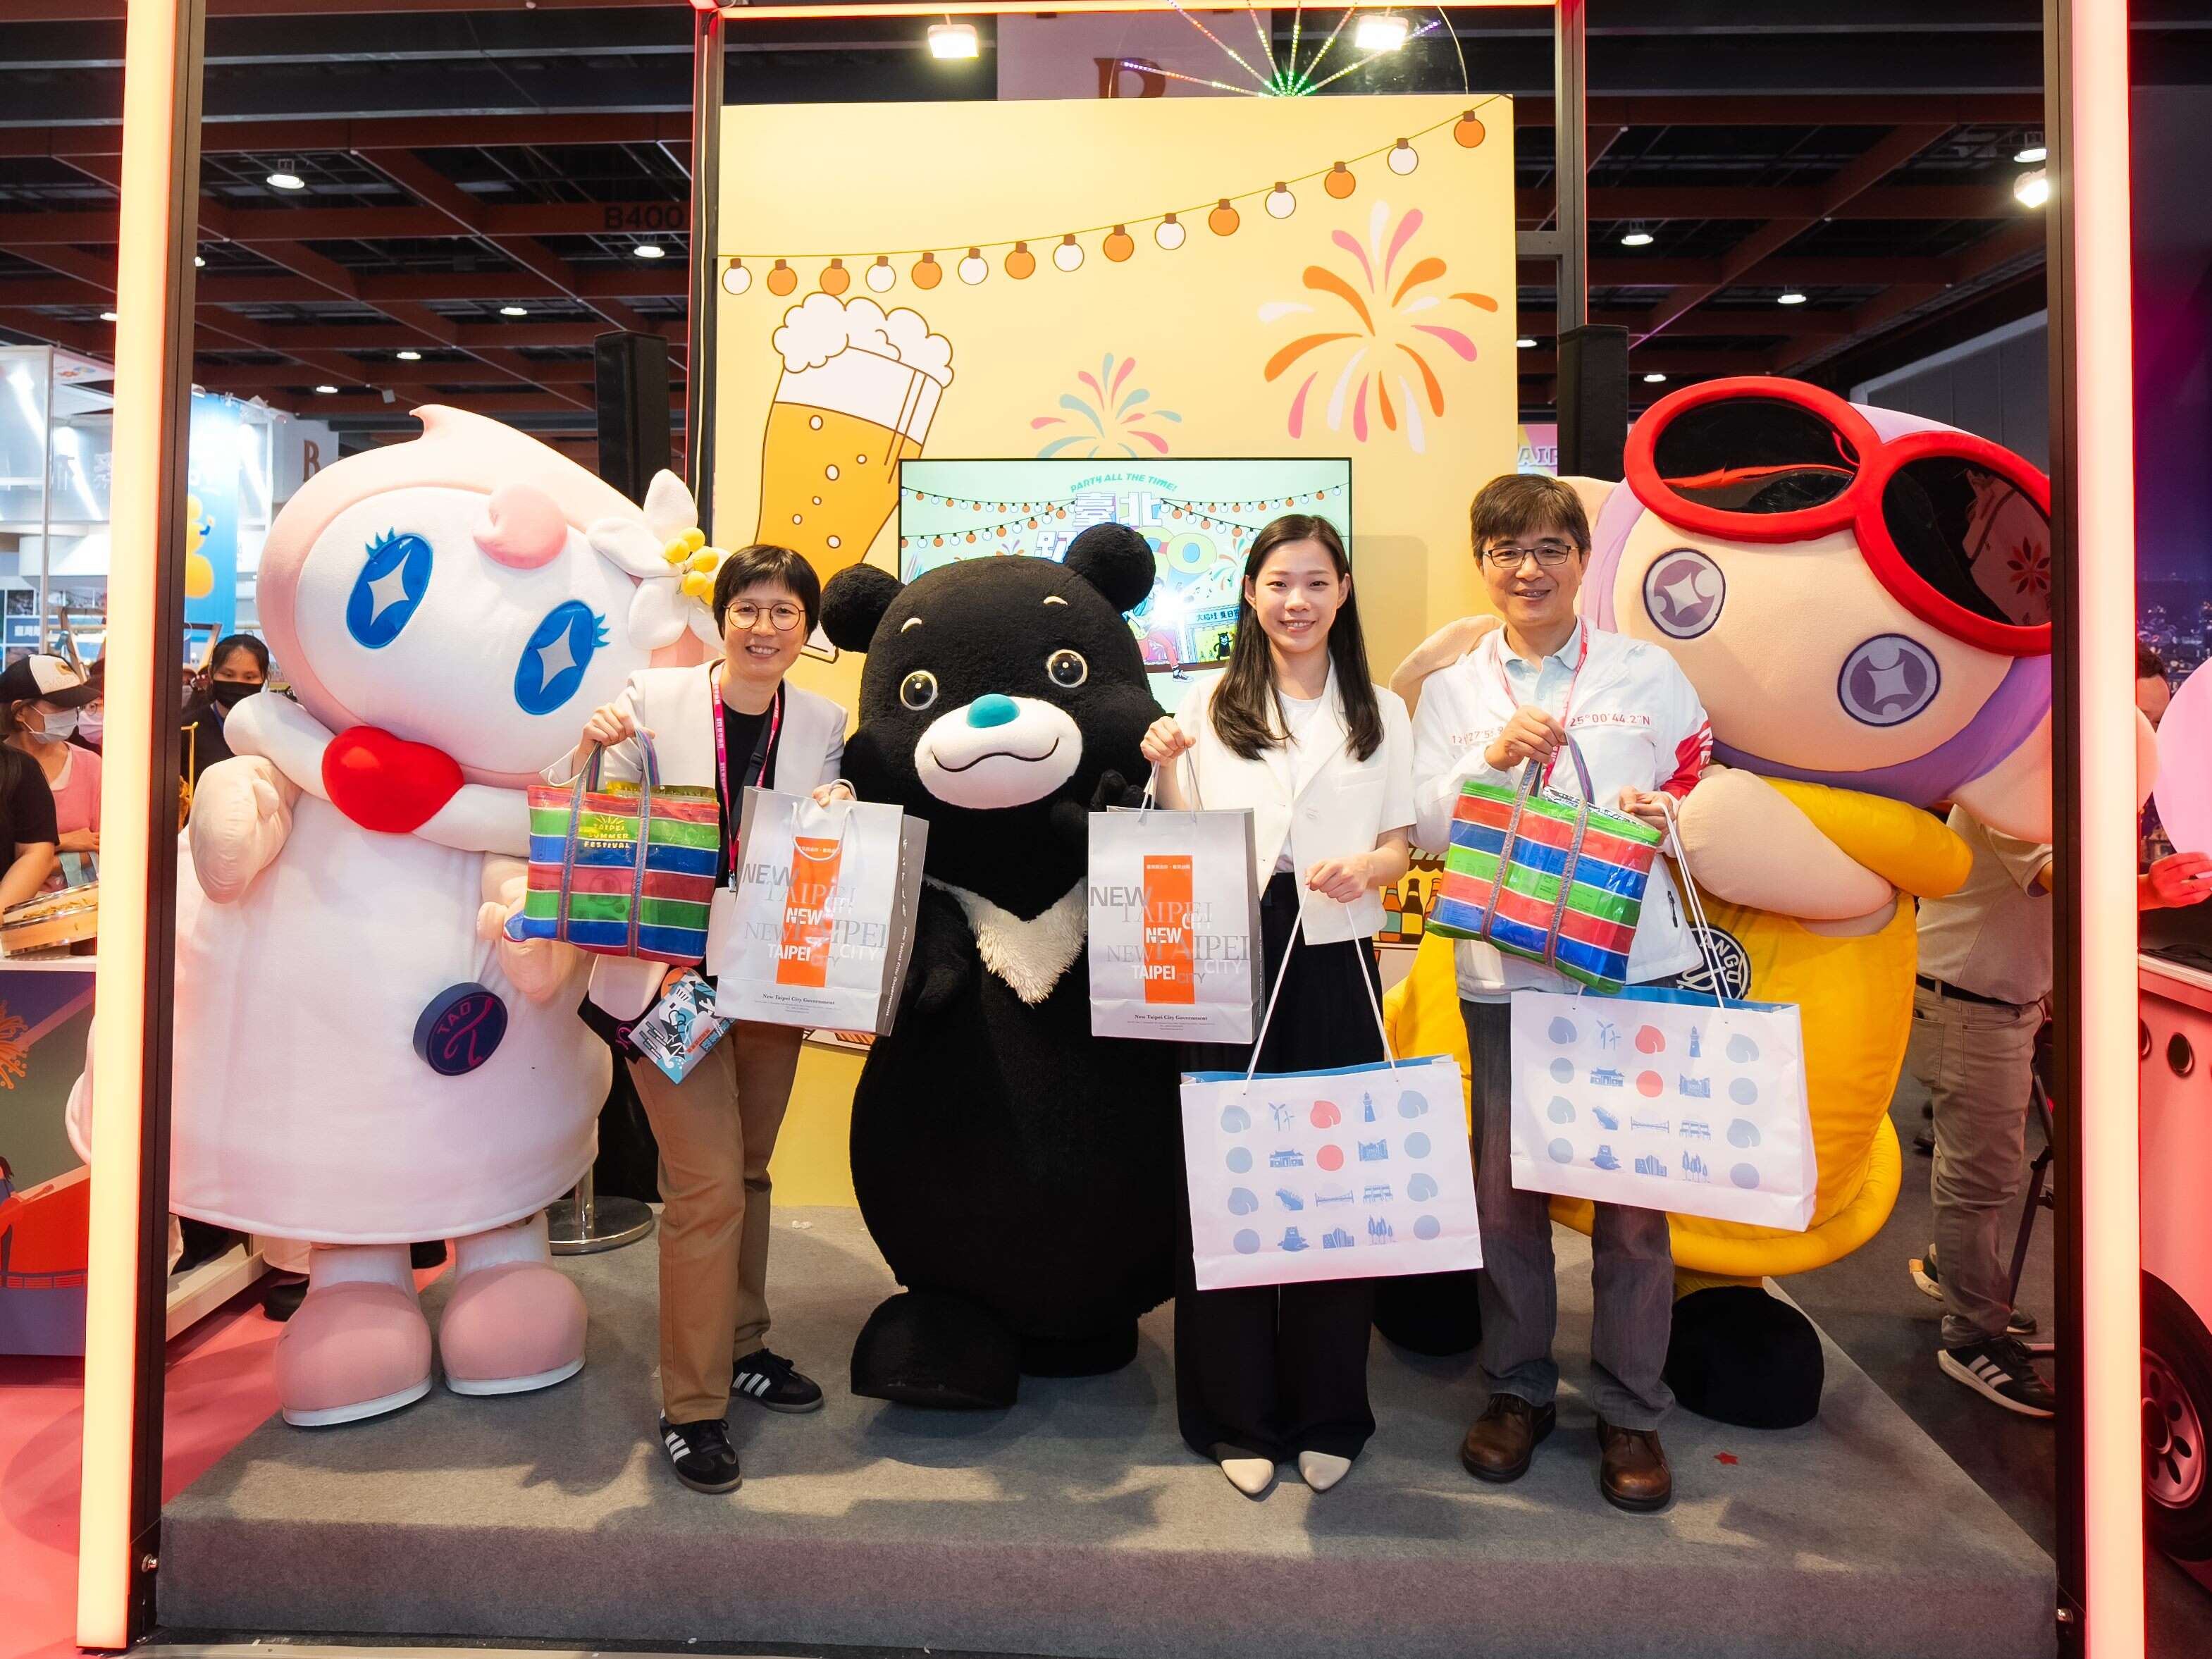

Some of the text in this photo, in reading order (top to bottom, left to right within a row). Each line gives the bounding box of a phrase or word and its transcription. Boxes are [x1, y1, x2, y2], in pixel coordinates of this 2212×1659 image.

[605, 204, 684, 228] B400
[1070, 474, 1178, 492] PARTY ALL THE TIME!
[1073, 492, 1163, 526] 臺北
[742, 863, 800, 887] NEW
[1090, 886, 1153, 908] NEW
[785, 907, 824, 925] NEW
[1122, 901, 1213, 923] TAIPEI
[744, 921, 793, 942] NEW
[1145, 927, 1182, 944] NEW
[767, 944, 812, 962] TAIPEI
[1106, 945, 1154, 963] NEW
[1131, 965, 1176, 980] TAIPEI
[1204, 960, 1242, 975] CITY
